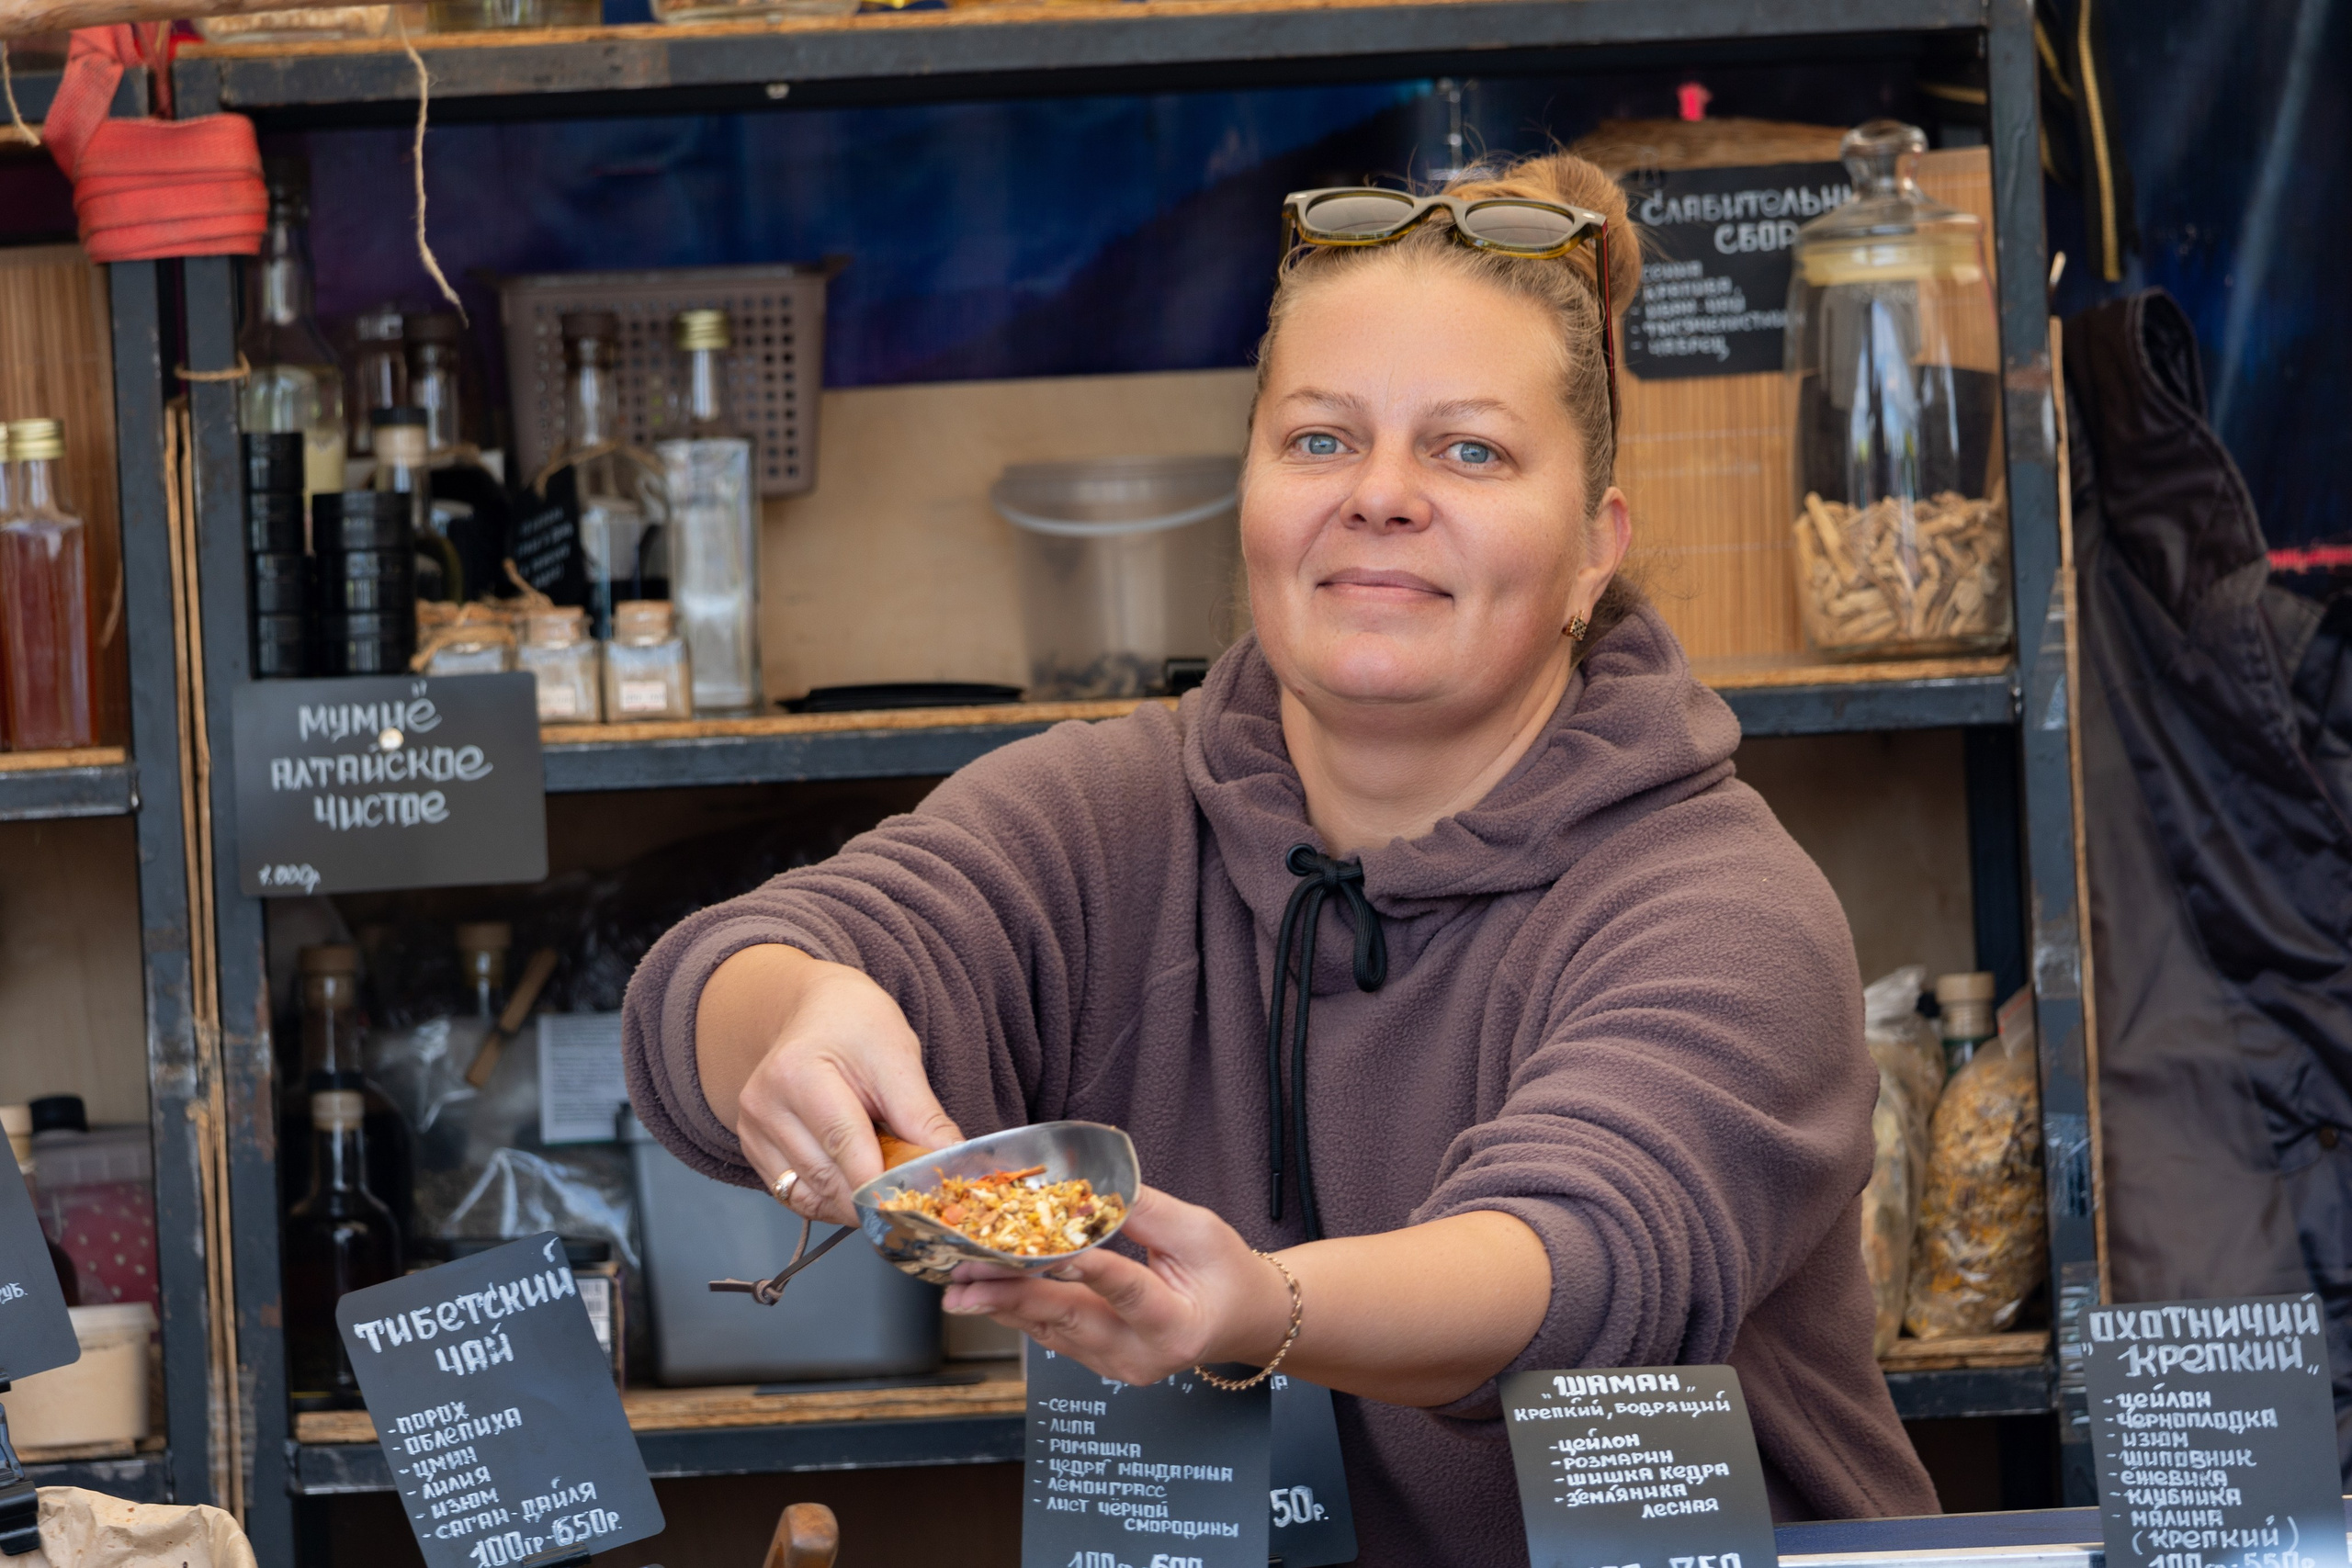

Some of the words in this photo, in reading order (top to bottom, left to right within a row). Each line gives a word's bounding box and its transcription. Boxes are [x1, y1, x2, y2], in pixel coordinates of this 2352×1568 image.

[1640, 184, 1853, 227] СЛАБИТЕЛЬН
[298, 680, 443, 743] МУМИЁ
[270, 742, 494, 791] АЛТАЙСКОЕ
[313, 790, 450, 831] ЧИСТОЕ
[0, 1282, 28, 1304] уб.
[353, 1236, 577, 1353] ТИБЕТСКИЙ
[2088, 1292, 2321, 1342] ОХОТНИЧИЙ
[435, 1322, 515, 1376] ЧАЙ
[1614, 1391, 1731, 1417] БОДРЯЩИЙ
[1118, 1461, 1233, 1483] МАНДАРИНА
[1660, 1462, 1730, 1485] КЕДРА
[1098, 1497, 1169, 1518] ЧЁРНОЙ
[1641, 1497, 1720, 1518] ЛЕСНАЯ
[1124, 1518, 1239, 1540] СМОРОДИНЫ
